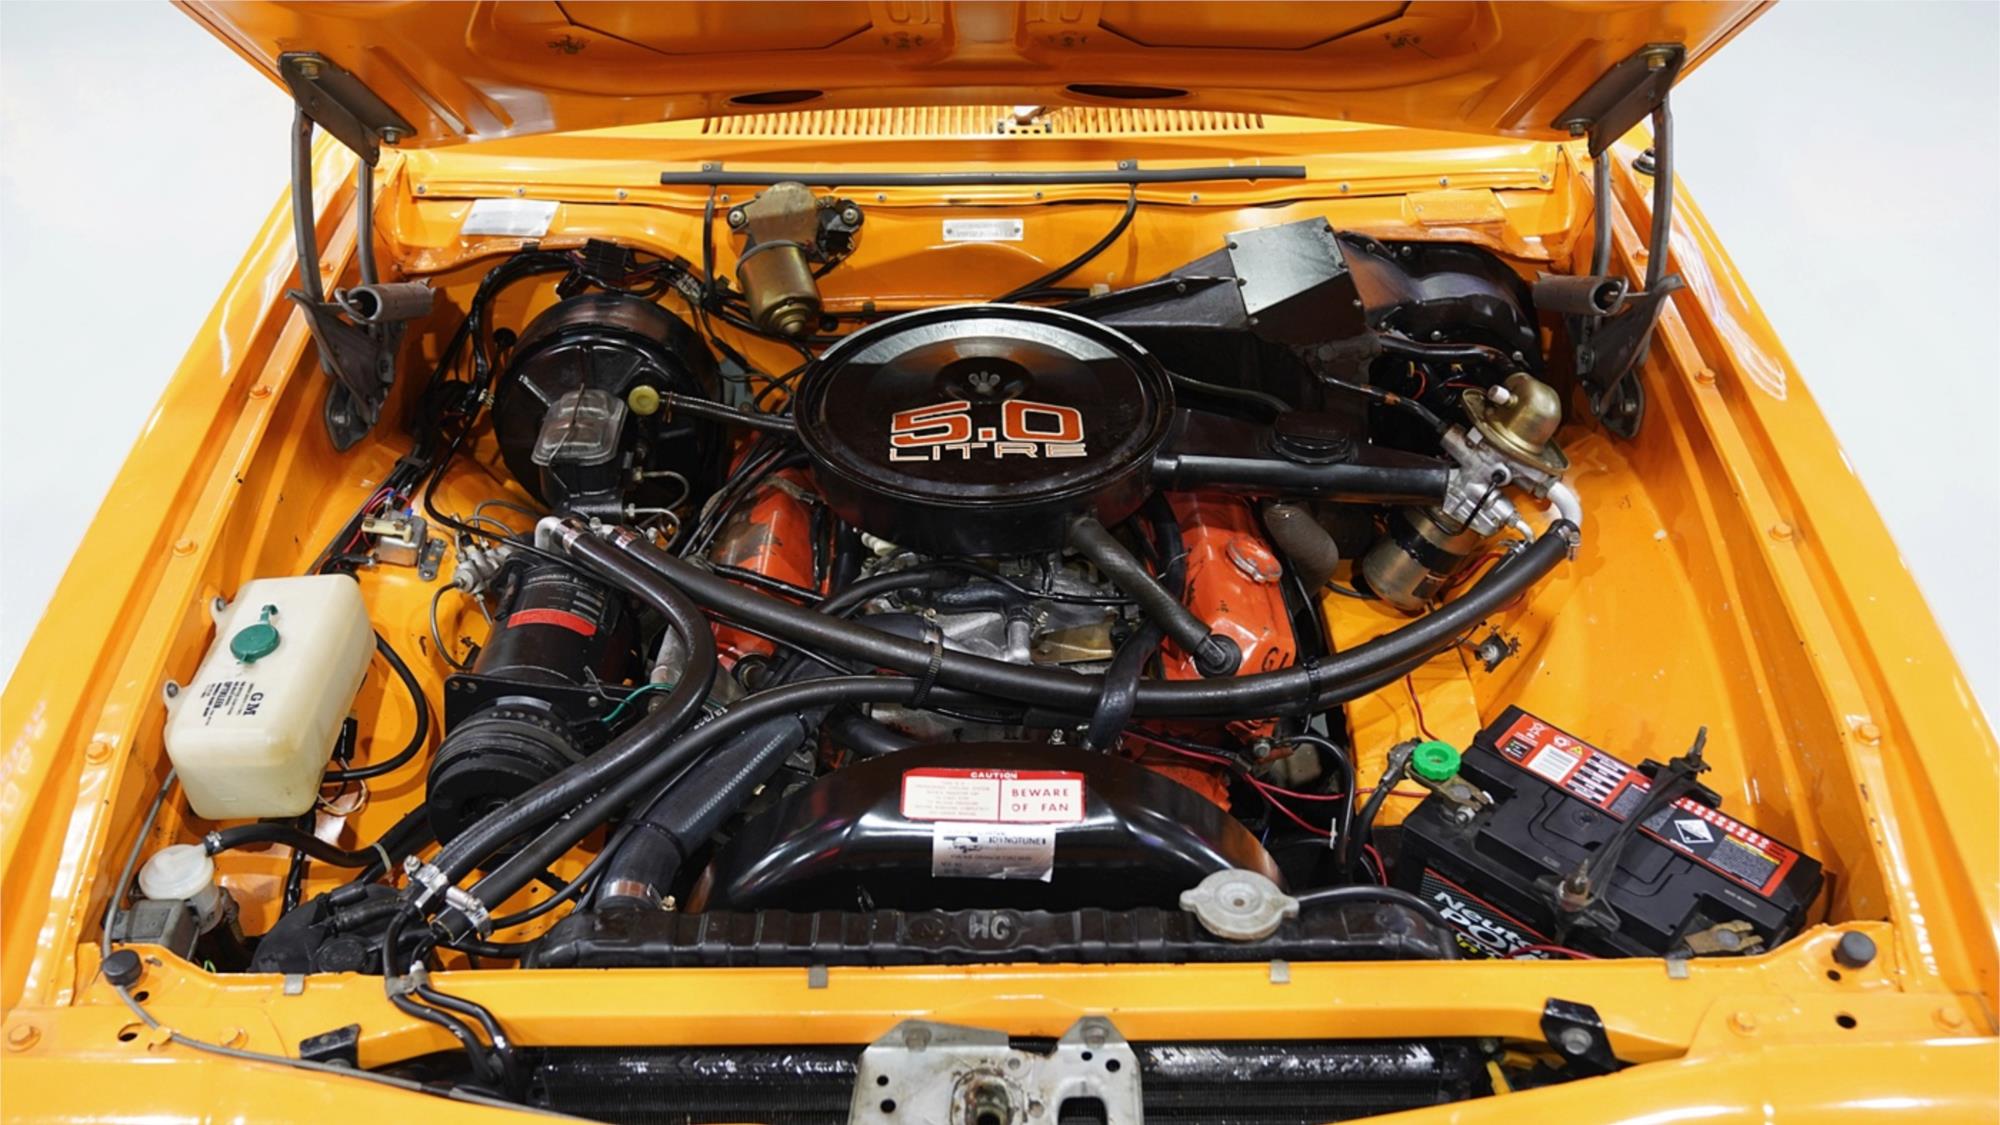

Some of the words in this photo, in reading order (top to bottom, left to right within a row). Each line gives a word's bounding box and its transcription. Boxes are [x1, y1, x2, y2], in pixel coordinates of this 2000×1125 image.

[890, 400, 1084, 447] 5.0
[889, 442, 1088, 462] LITRE
[970, 771, 1018, 780] CAUTION
[1011, 788, 1069, 797] BEWARE
[1011, 803, 1028, 812] OF
[1041, 803, 1069, 812] FAN
[968, 914, 1010, 941] HG
